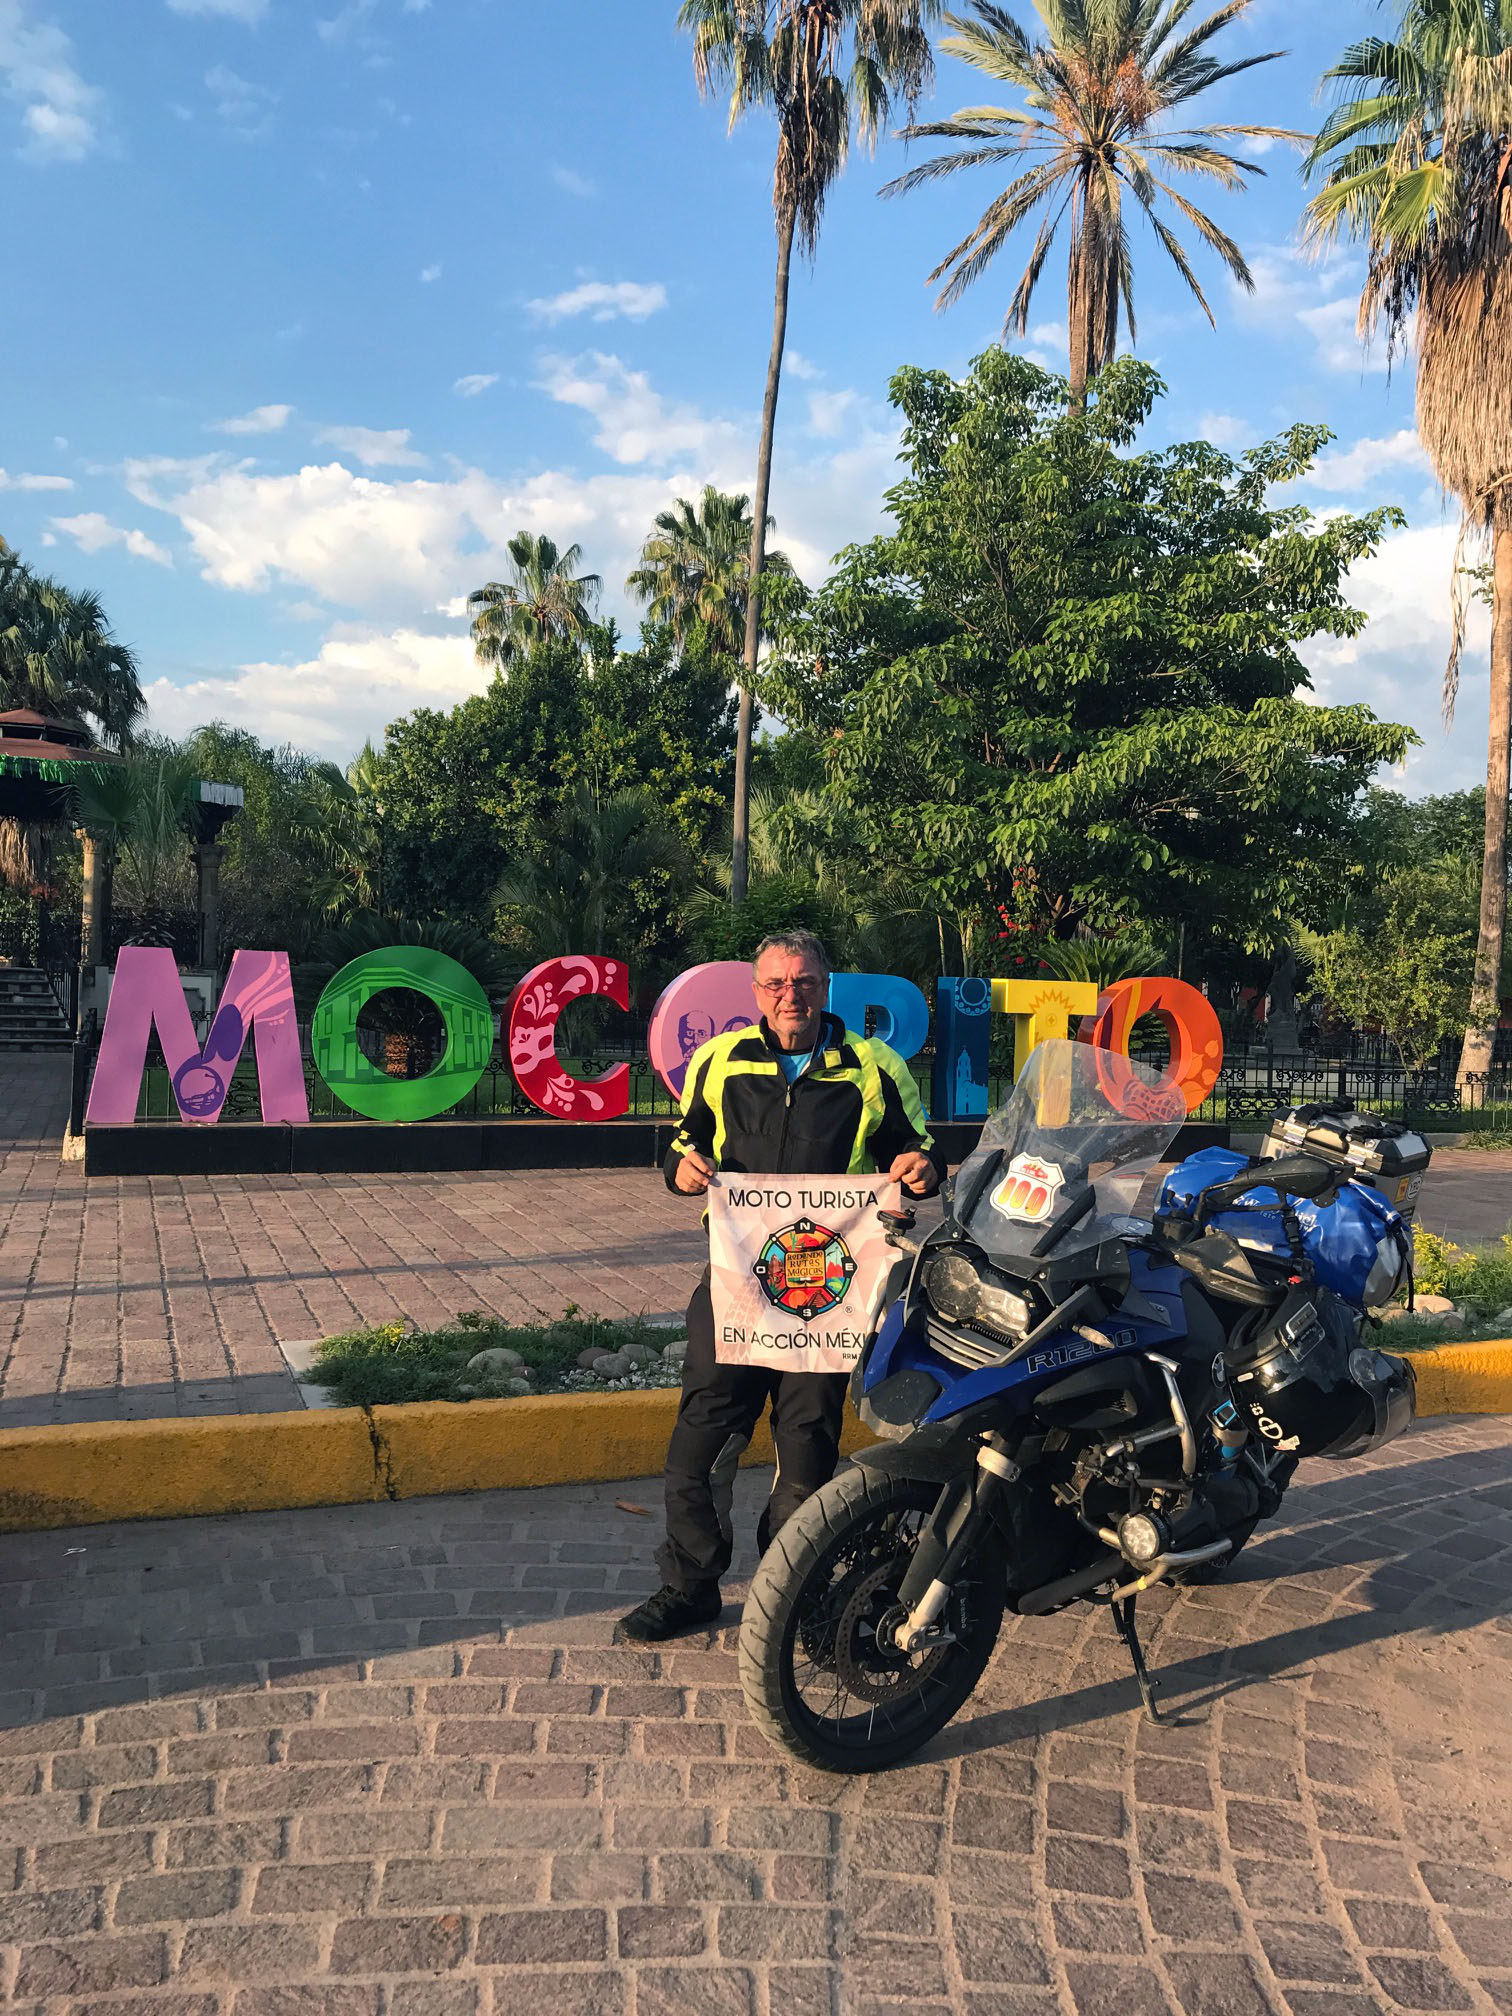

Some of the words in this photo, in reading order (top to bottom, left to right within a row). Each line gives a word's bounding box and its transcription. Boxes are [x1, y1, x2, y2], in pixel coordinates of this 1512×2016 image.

[728, 1189, 792, 1208] MOTO
[798, 1190, 879, 1209] TURISTA
[800, 1222, 811, 1231] N
[844, 1262, 854, 1271] E
[802, 1308, 812, 1317] S
[723, 1326, 746, 1343] EN
[750, 1328, 821, 1349] ACCIÓN
[826, 1328, 867, 1349] MÉXI
